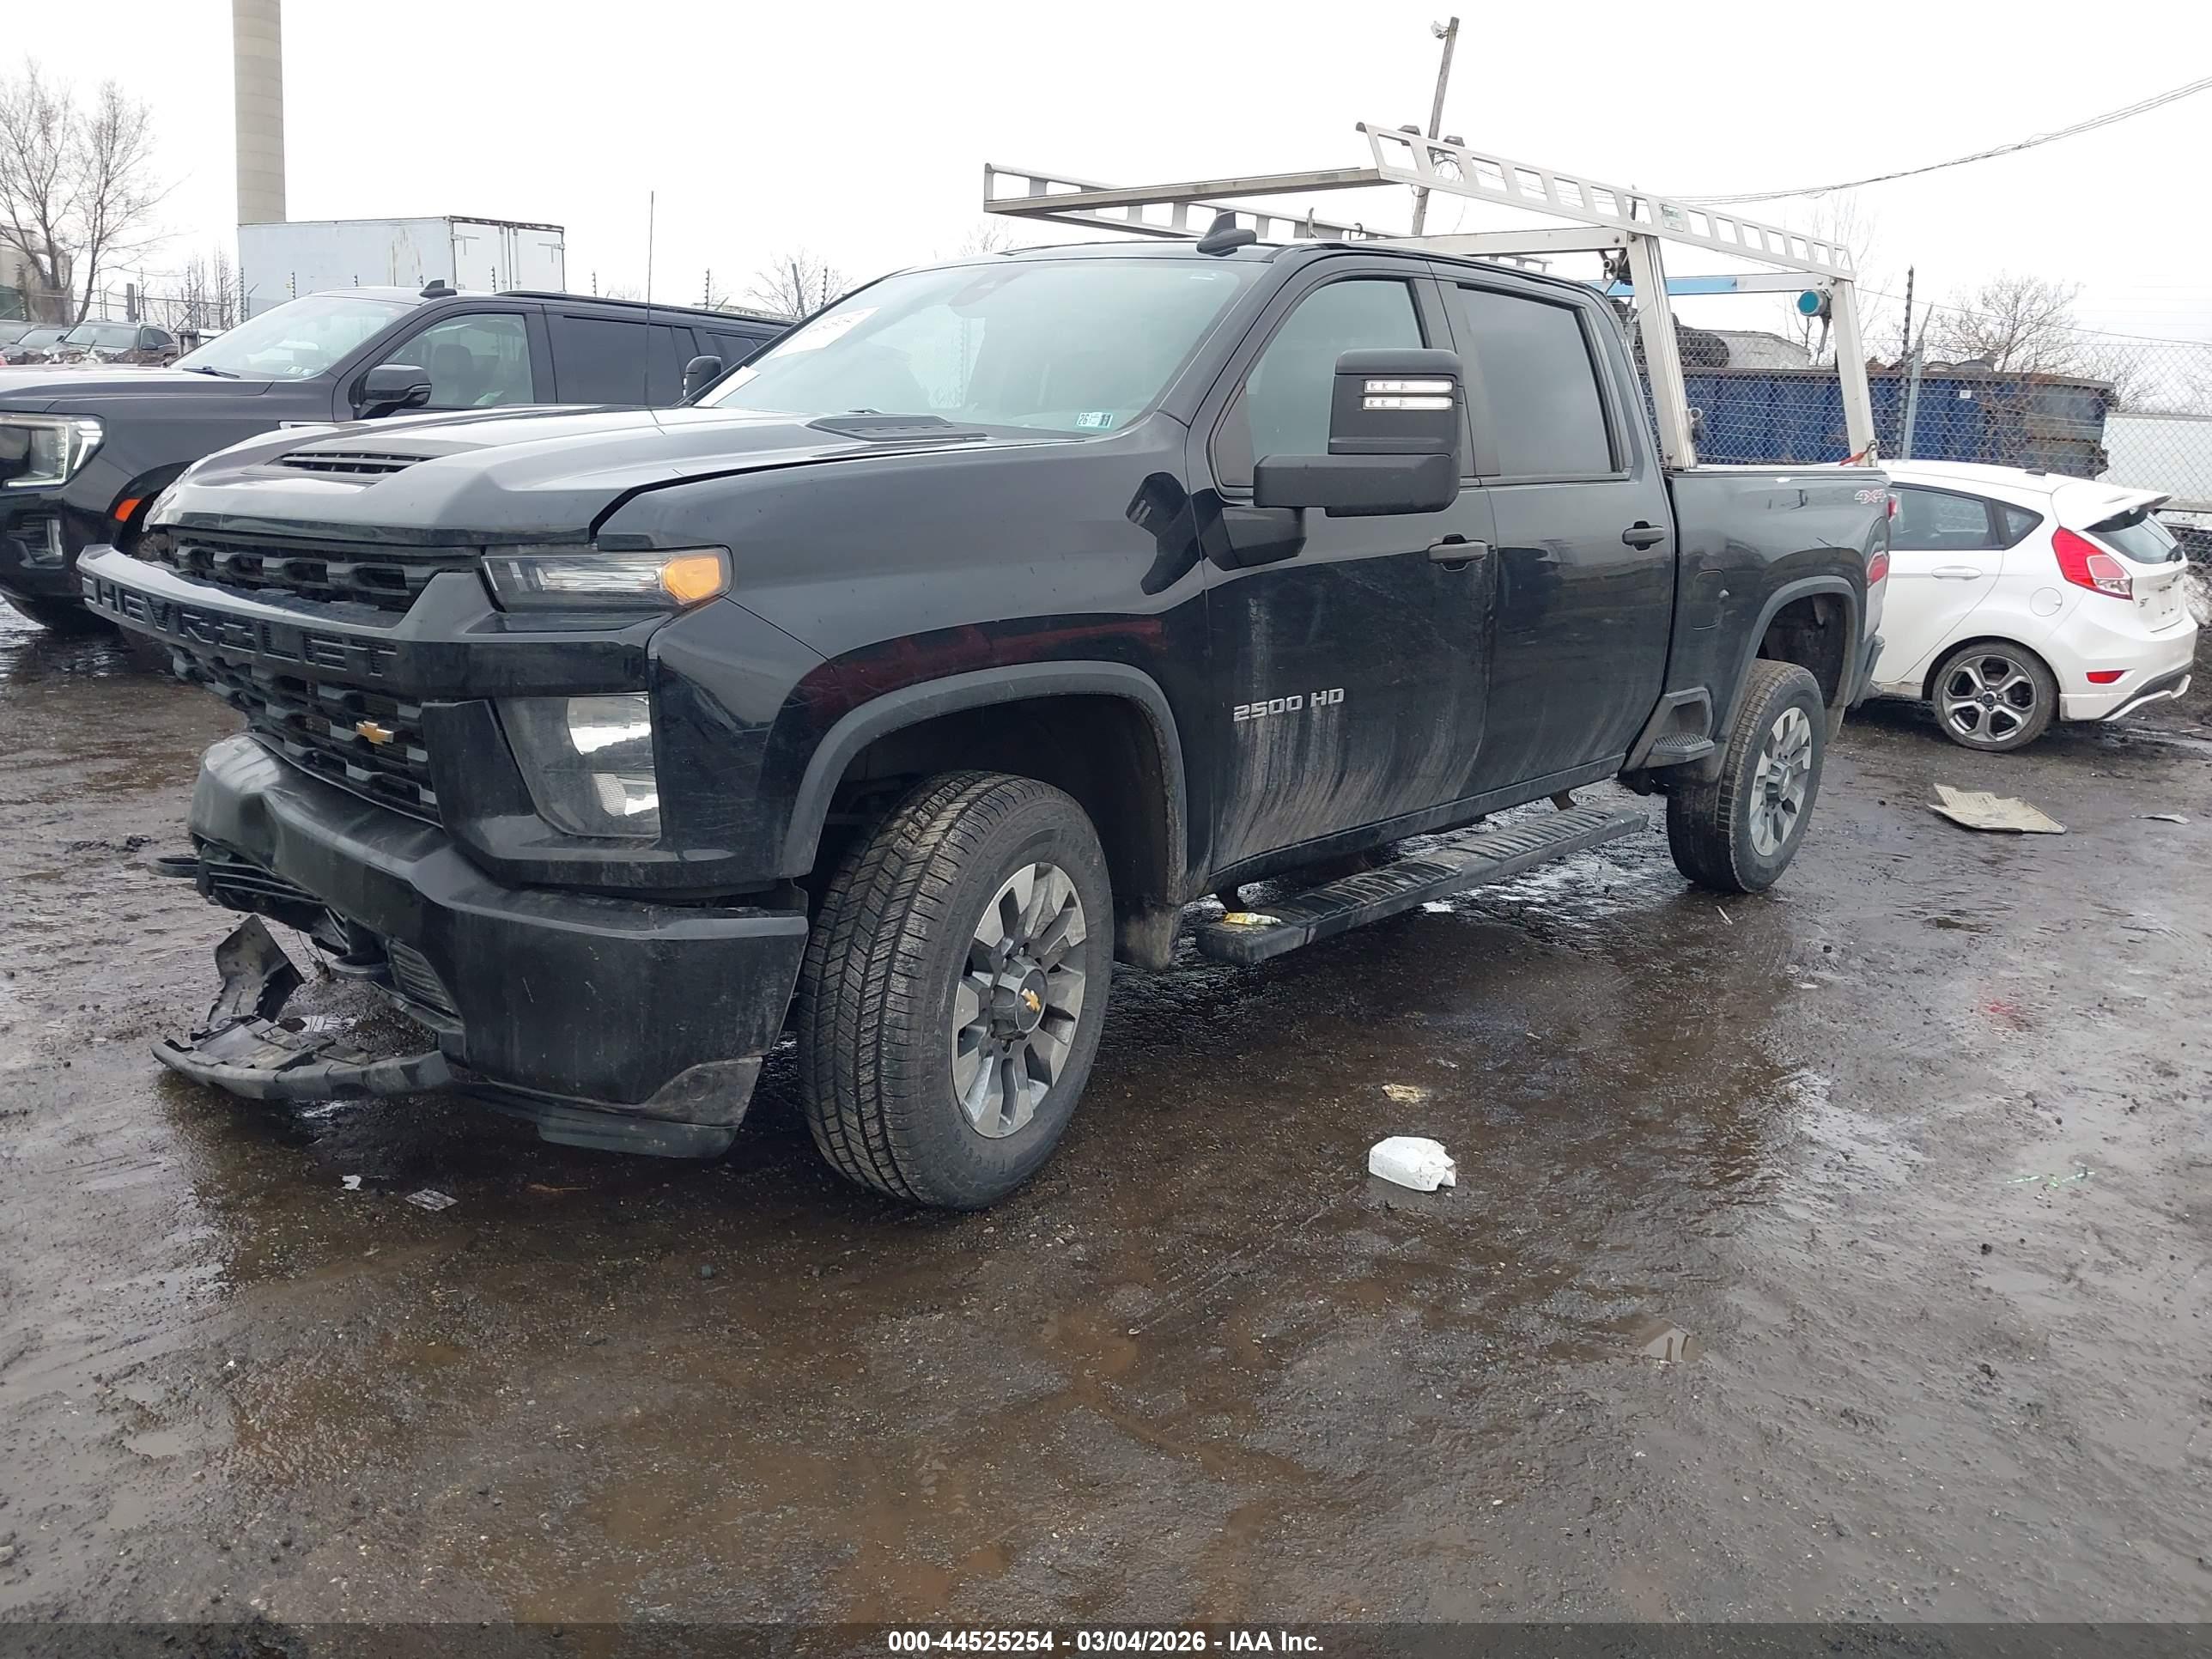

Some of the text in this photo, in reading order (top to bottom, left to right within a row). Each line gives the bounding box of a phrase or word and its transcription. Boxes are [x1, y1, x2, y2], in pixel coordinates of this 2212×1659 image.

[81, 575, 398, 678] CHEVROLET
[1233, 688, 1345, 722] 2500 HD
